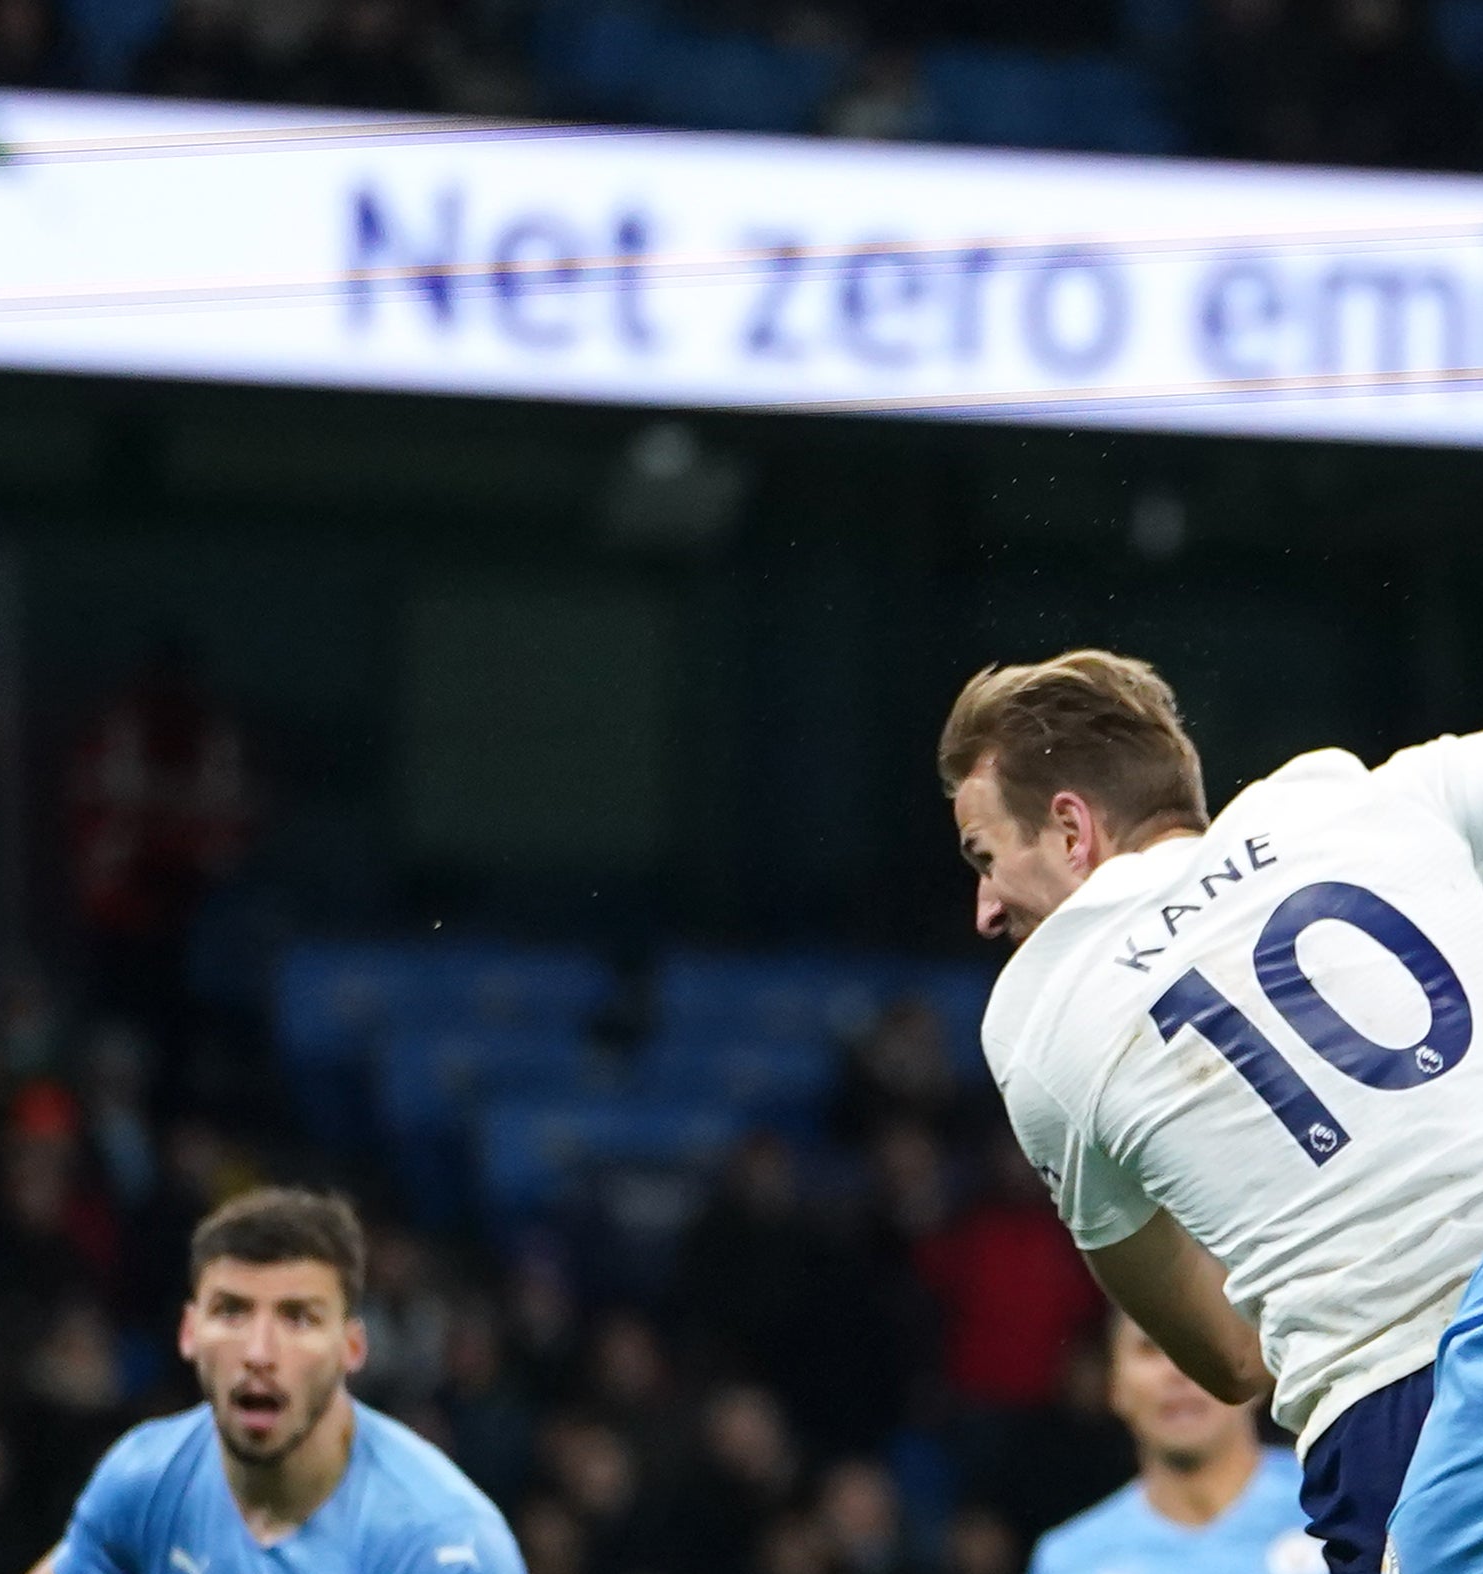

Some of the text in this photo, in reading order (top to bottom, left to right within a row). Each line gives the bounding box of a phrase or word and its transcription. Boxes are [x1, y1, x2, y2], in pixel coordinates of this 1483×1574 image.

[342, 176, 668, 356] Net
[738, 220, 1134, 384] zero
[1114, 832, 1279, 974] KANE
[1148, 881, 1474, 1168] 10
